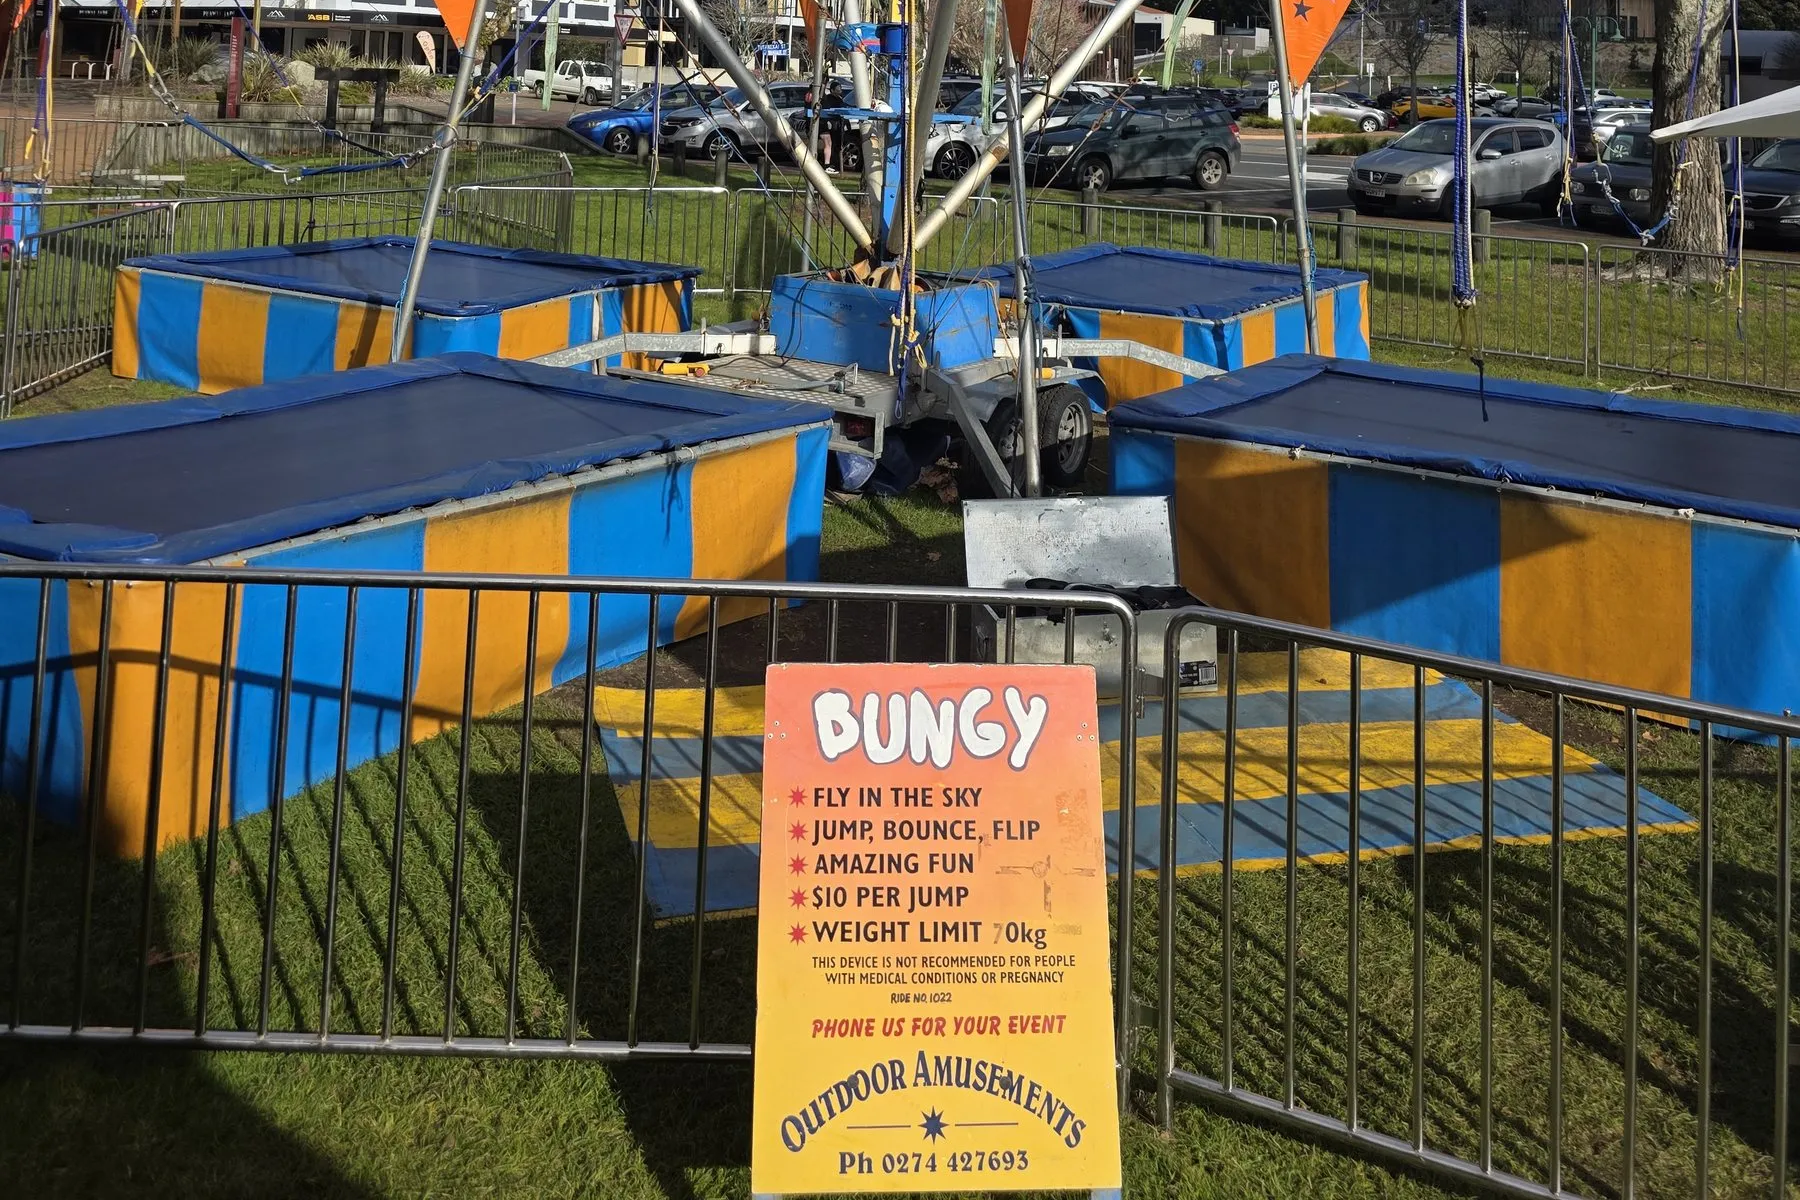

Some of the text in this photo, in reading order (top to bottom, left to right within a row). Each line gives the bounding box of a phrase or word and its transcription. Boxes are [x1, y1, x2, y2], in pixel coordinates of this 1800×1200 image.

[812, 687, 1049, 770] BUNGY
[813, 787, 983, 808] FLY IN THE SKY
[811, 819, 1041, 847] JUMP, BOUNCE, FLIP
[814, 852, 974, 875] AMAZING FUN
[812, 885, 969, 914] $10 PER JUMP
[811, 920, 911, 943] WEIGHT
[919, 921, 983, 943] LIMIT
[811, 954, 1076, 969] THIS DEVICE IS NOT RECOMMENDED FOR PEOPLE
[825, 970, 1065, 985] WITH MEDICAL CONDITIONS OR PREGNANCY
[890, 992, 911, 1004] RIDE
[929, 991, 953, 1004] 1022
[811, 1014, 1067, 1039] PHONE US FOR YOUR EVENT
[780, 1050, 1088, 1153] OUTDOOR AMUSEMENTS
[838, 1149, 1029, 1175] Ph 0274 427693
